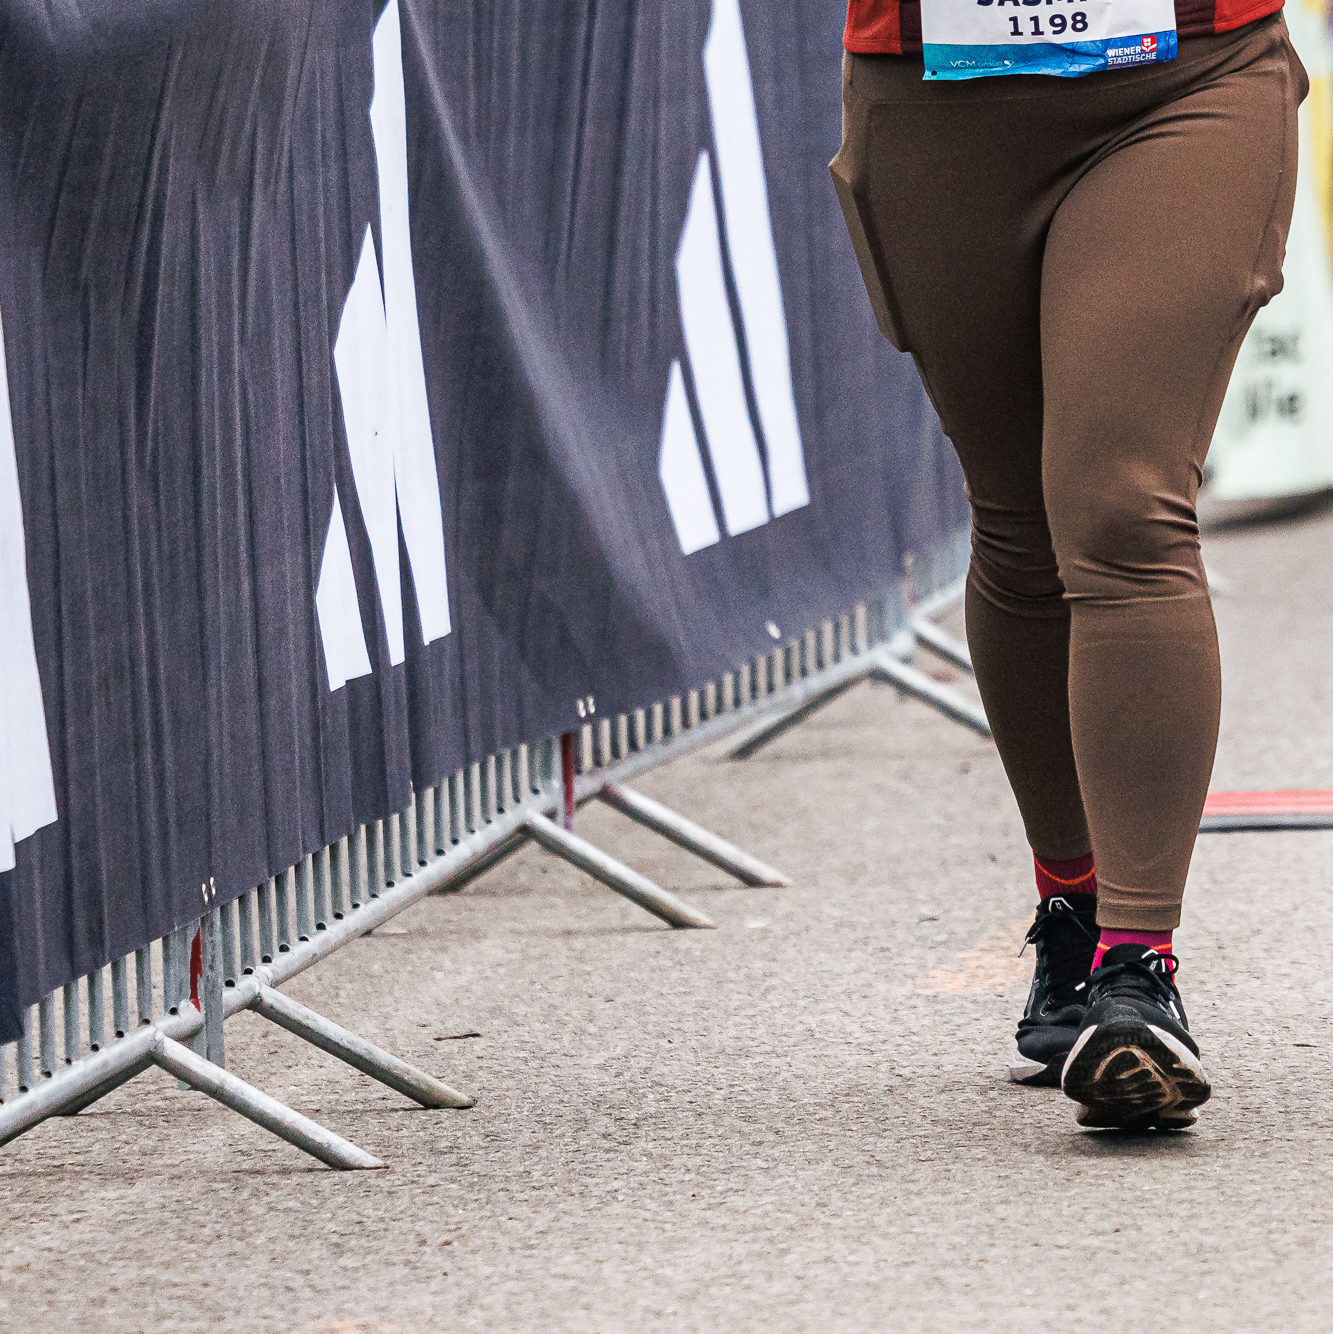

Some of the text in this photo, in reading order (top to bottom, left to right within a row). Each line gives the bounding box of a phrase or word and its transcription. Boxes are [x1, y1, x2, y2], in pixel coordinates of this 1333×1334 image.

[1008, 11, 1089, 37] 1198
[1106, 46, 1142, 57] WIENER
[949, 60, 976, 68] VCM
